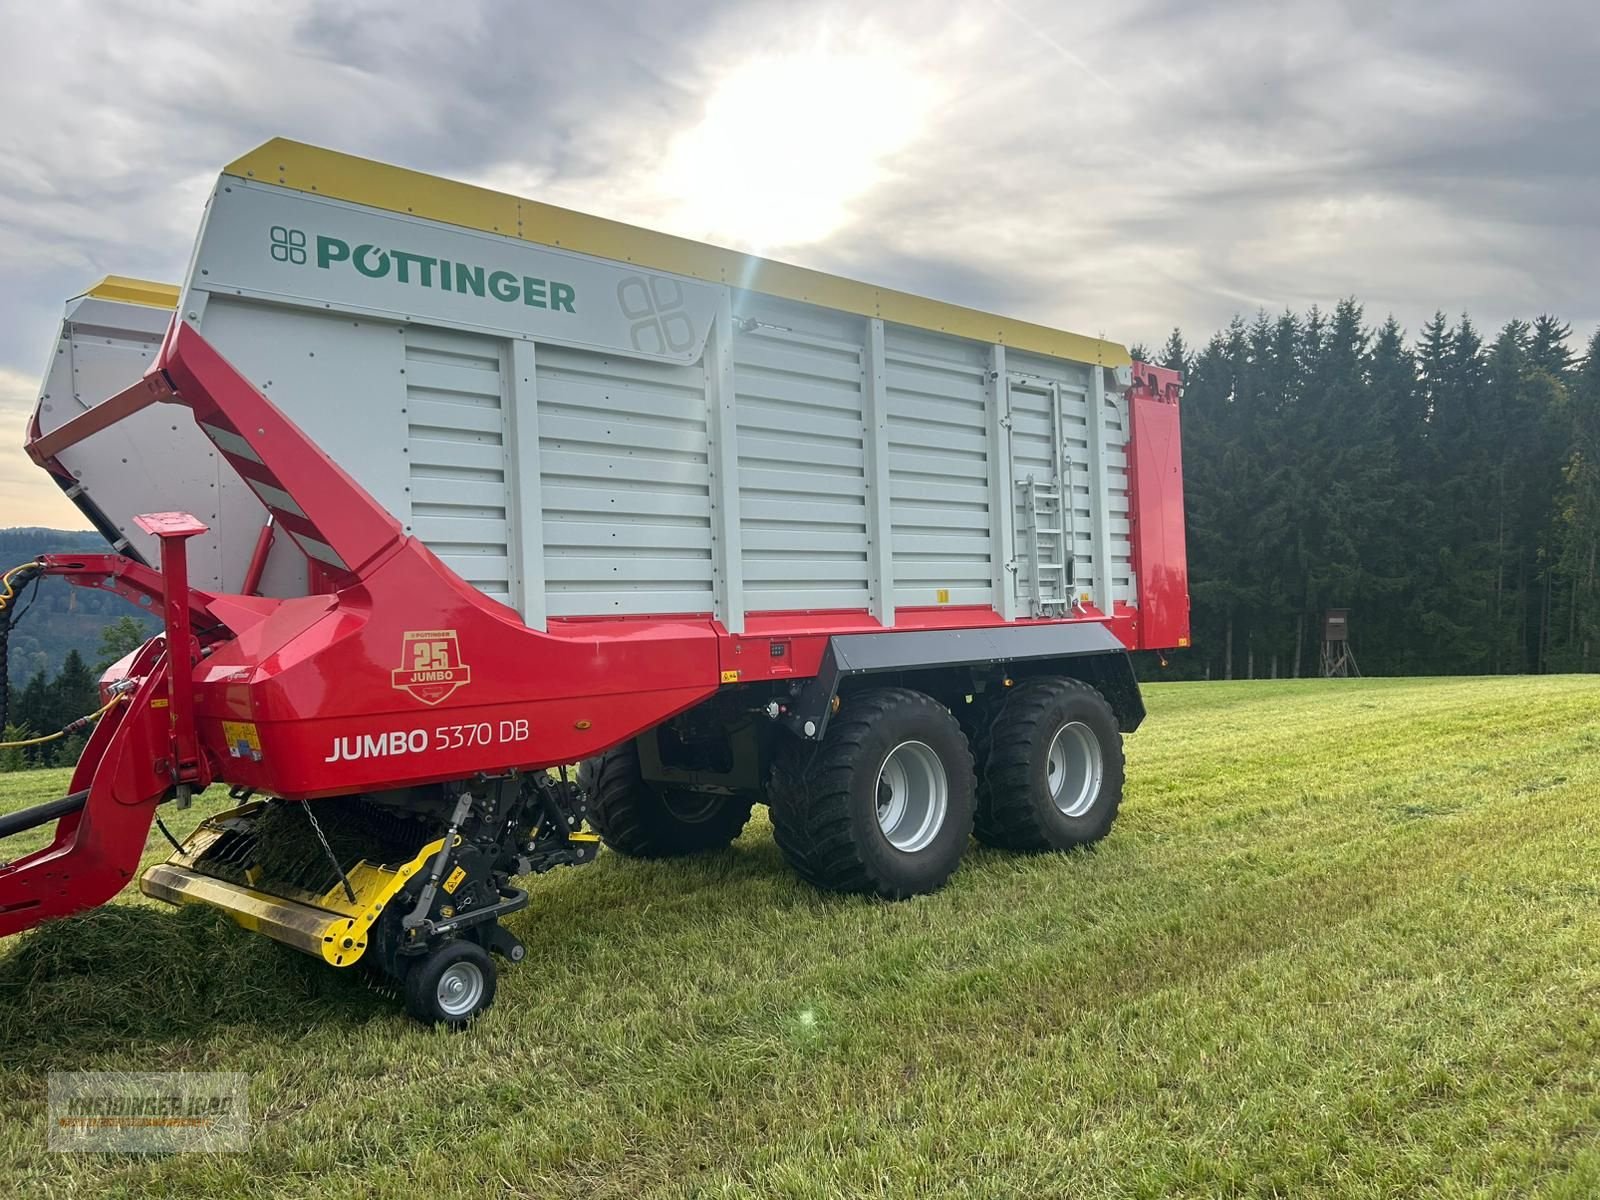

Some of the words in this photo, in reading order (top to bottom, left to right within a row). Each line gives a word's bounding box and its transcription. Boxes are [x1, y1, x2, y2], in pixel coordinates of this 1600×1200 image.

[316, 235, 576, 314] PÖTTINGER
[414, 642, 448, 670] 25
[410, 670, 453, 682] JUMBO
[325, 729, 428, 763] JUMBO
[435, 723, 492, 751] 5370
[499, 719, 529, 743] DB
